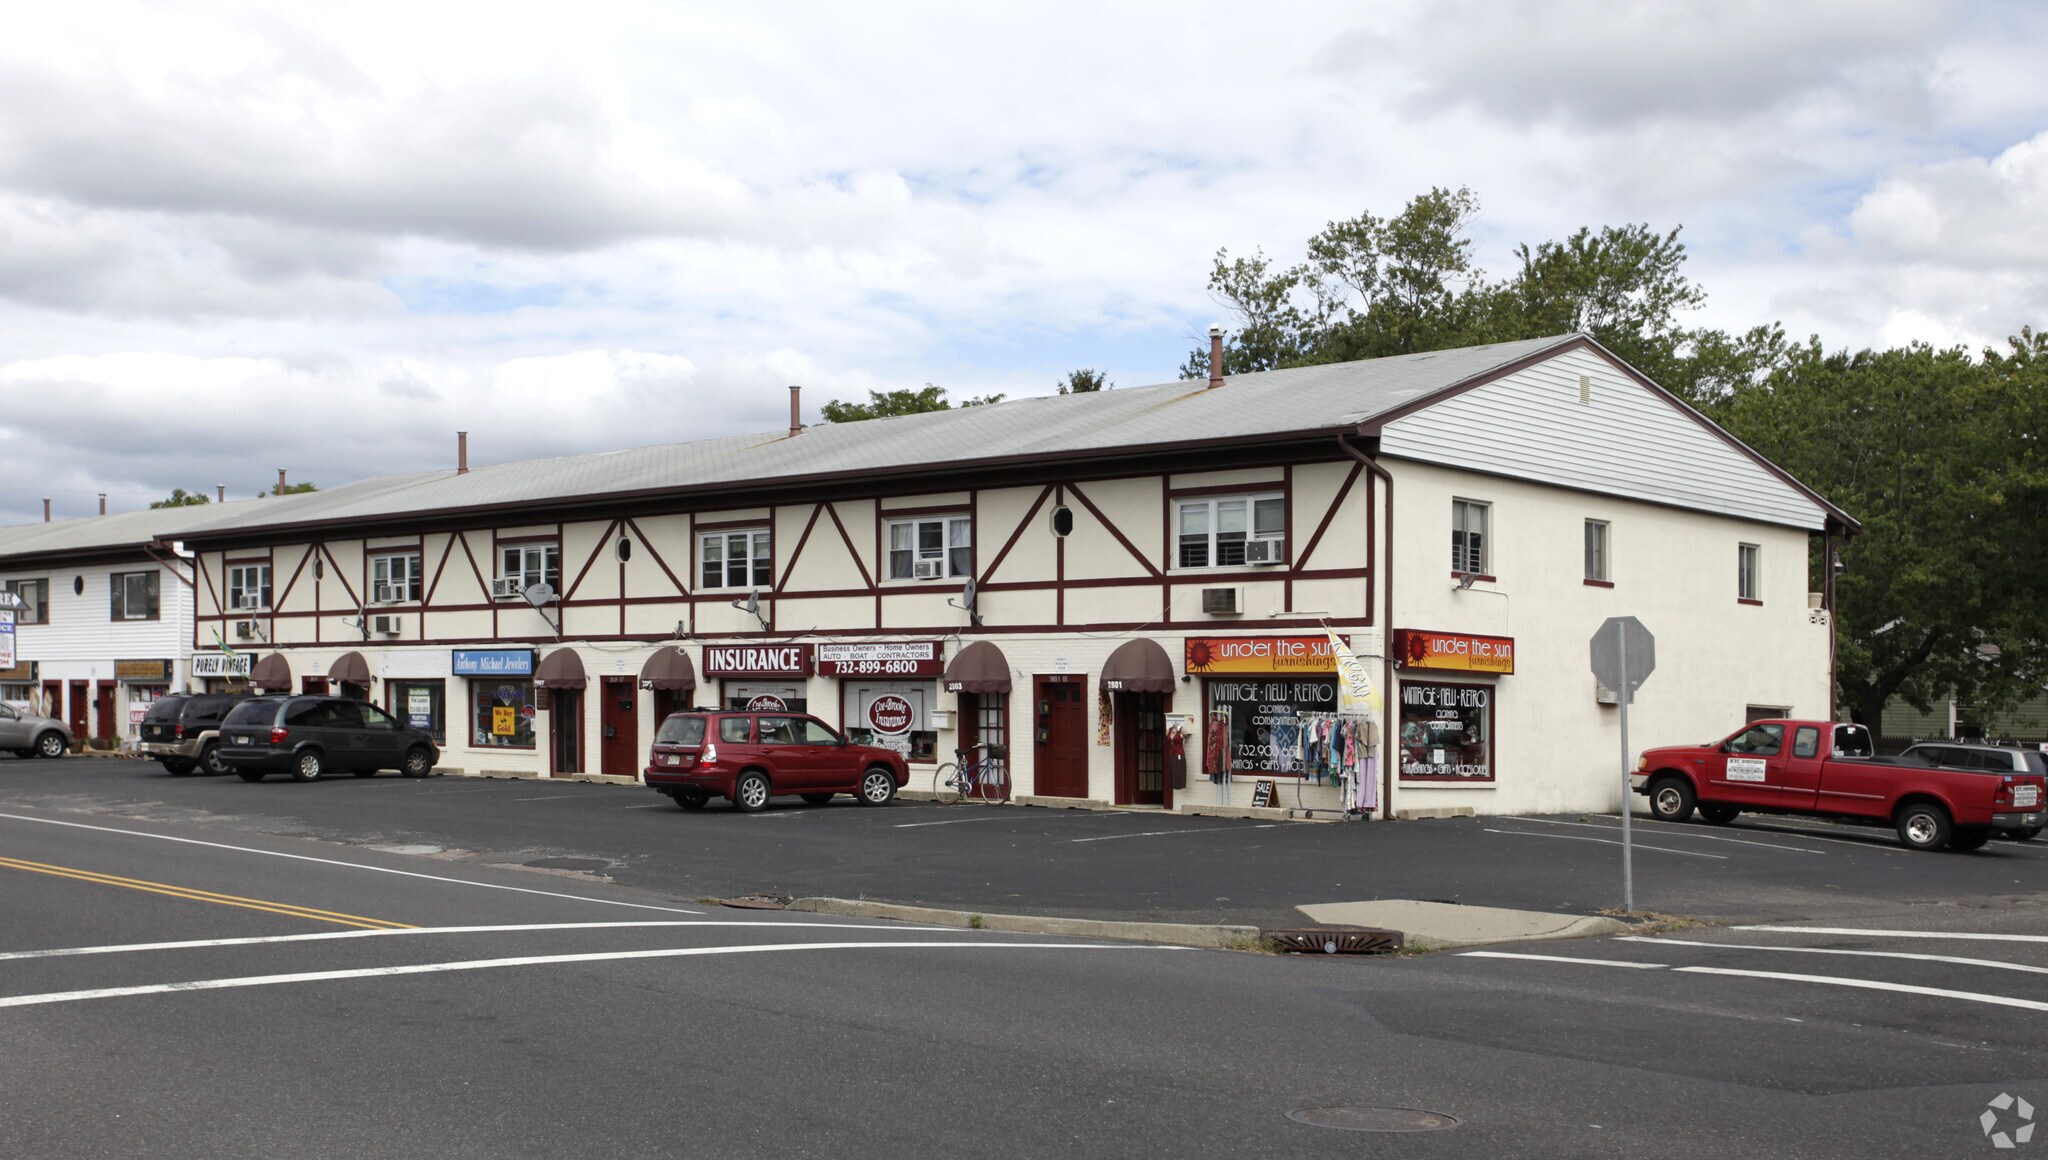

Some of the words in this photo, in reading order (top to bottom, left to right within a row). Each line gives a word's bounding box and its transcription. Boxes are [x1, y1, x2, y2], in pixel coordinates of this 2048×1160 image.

[852, 644, 876, 652] Owners
[1221, 640, 1271, 657] under
[1276, 640, 1305, 656] the
[1432, 638, 1468, 654] under
[1472, 638, 1491, 656] the
[1494, 644, 1511, 657] sun
[195, 657, 219, 673] PURELY
[456, 657, 478, 672] Anthony
[480, 656, 503, 670] Michael
[505, 656, 529, 670] Jewelers
[709, 648, 800, 671] INSURANCE
[835, 660, 918, 674] 732-899-6800
[1272, 653, 1336, 670] furnishings
[1468, 652, 1511, 671] furnishings
[1214, 683, 1258, 701] VINTAGE
[1265, 683, 1287, 702] NEW
[1294, 683, 1333, 702] RETRO
[1403, 686, 1436, 705] VINTAGE
[1440, 688, 1457, 706] NEW
[1460, 689, 1486, 707] RETRO
[1258, 704, 1291, 714] CLOTHING
[875, 712, 907, 728] Insurance
[497, 724, 511, 733] Gold
[1260, 759, 1280, 771] GIFTS
[1256, 782, 1270, 793] SALE
